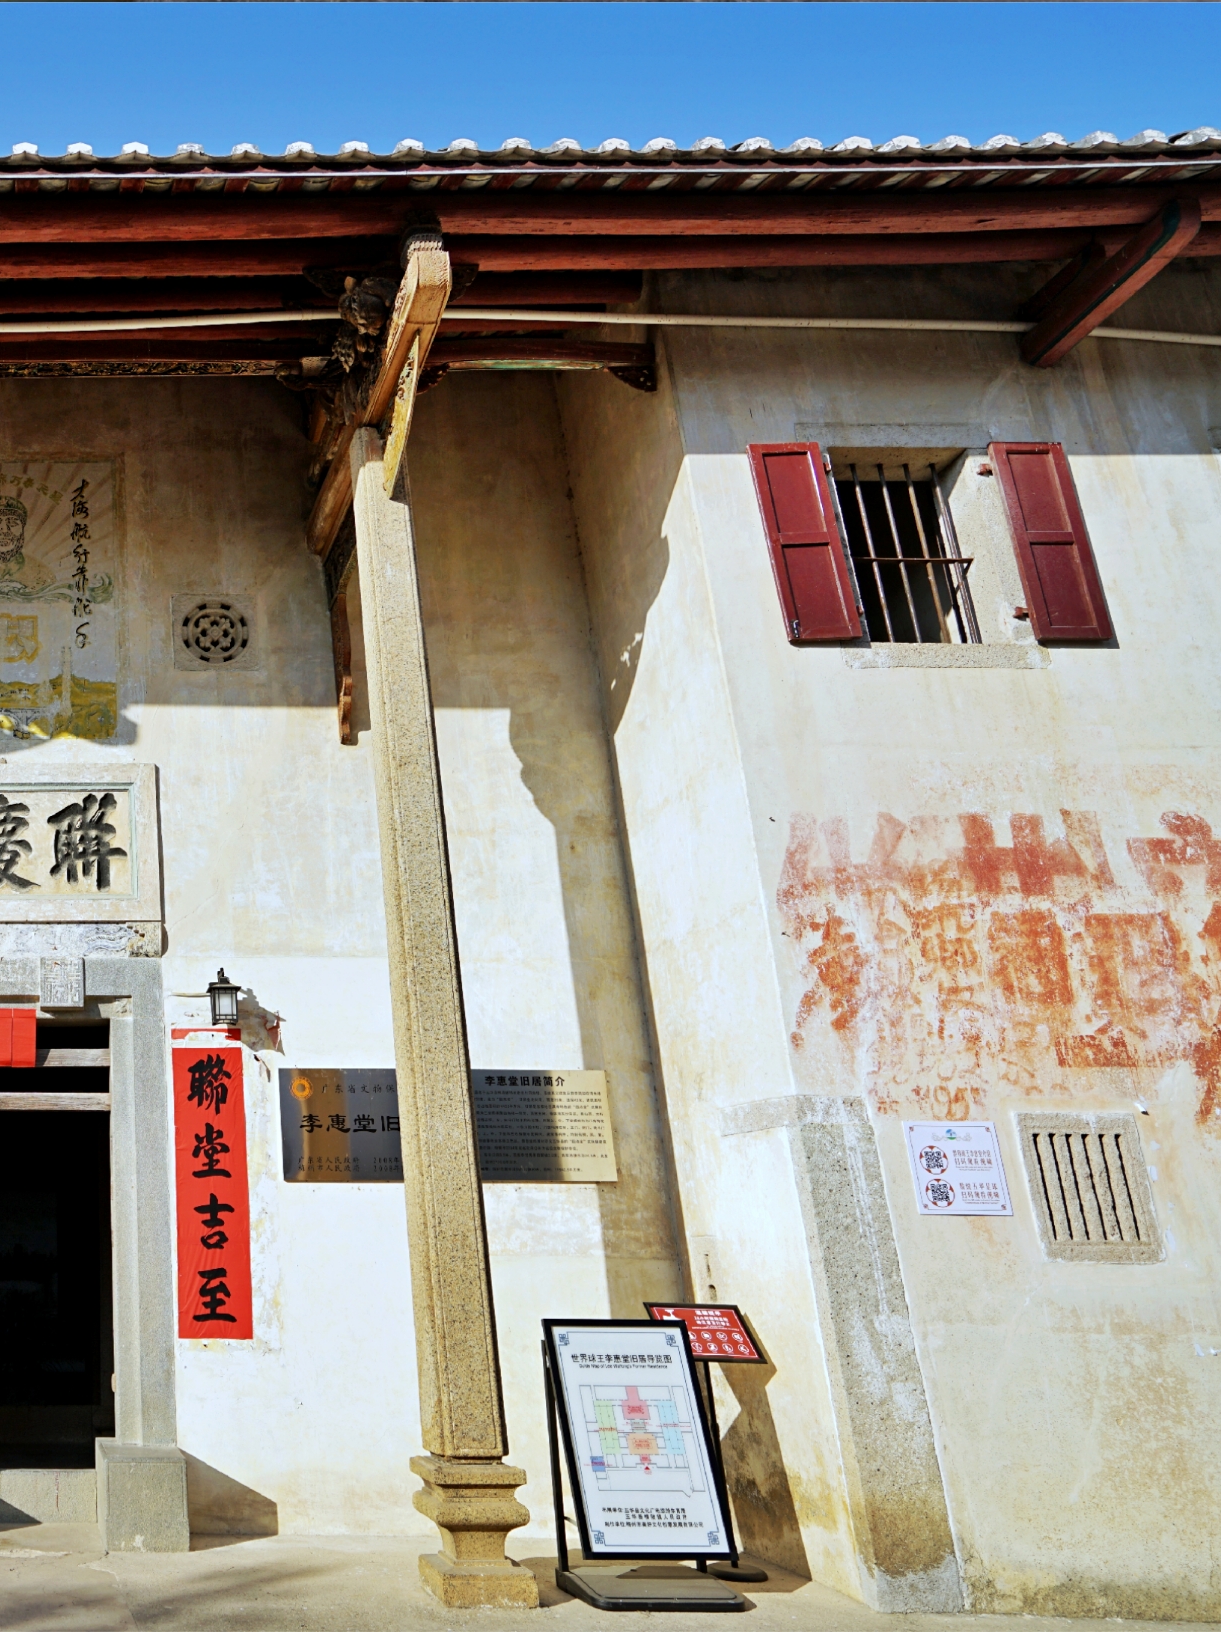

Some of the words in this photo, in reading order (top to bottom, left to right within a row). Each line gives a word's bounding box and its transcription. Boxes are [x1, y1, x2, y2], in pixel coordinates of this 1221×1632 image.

[322, 1084, 395, 1094] 广东省文物保
[484, 1075, 565, 1087] 李惠堂旧居简介
[299, 1113, 400, 1133] 李惠堂旧
[187, 1054, 237, 1323] 聯堂吉至
